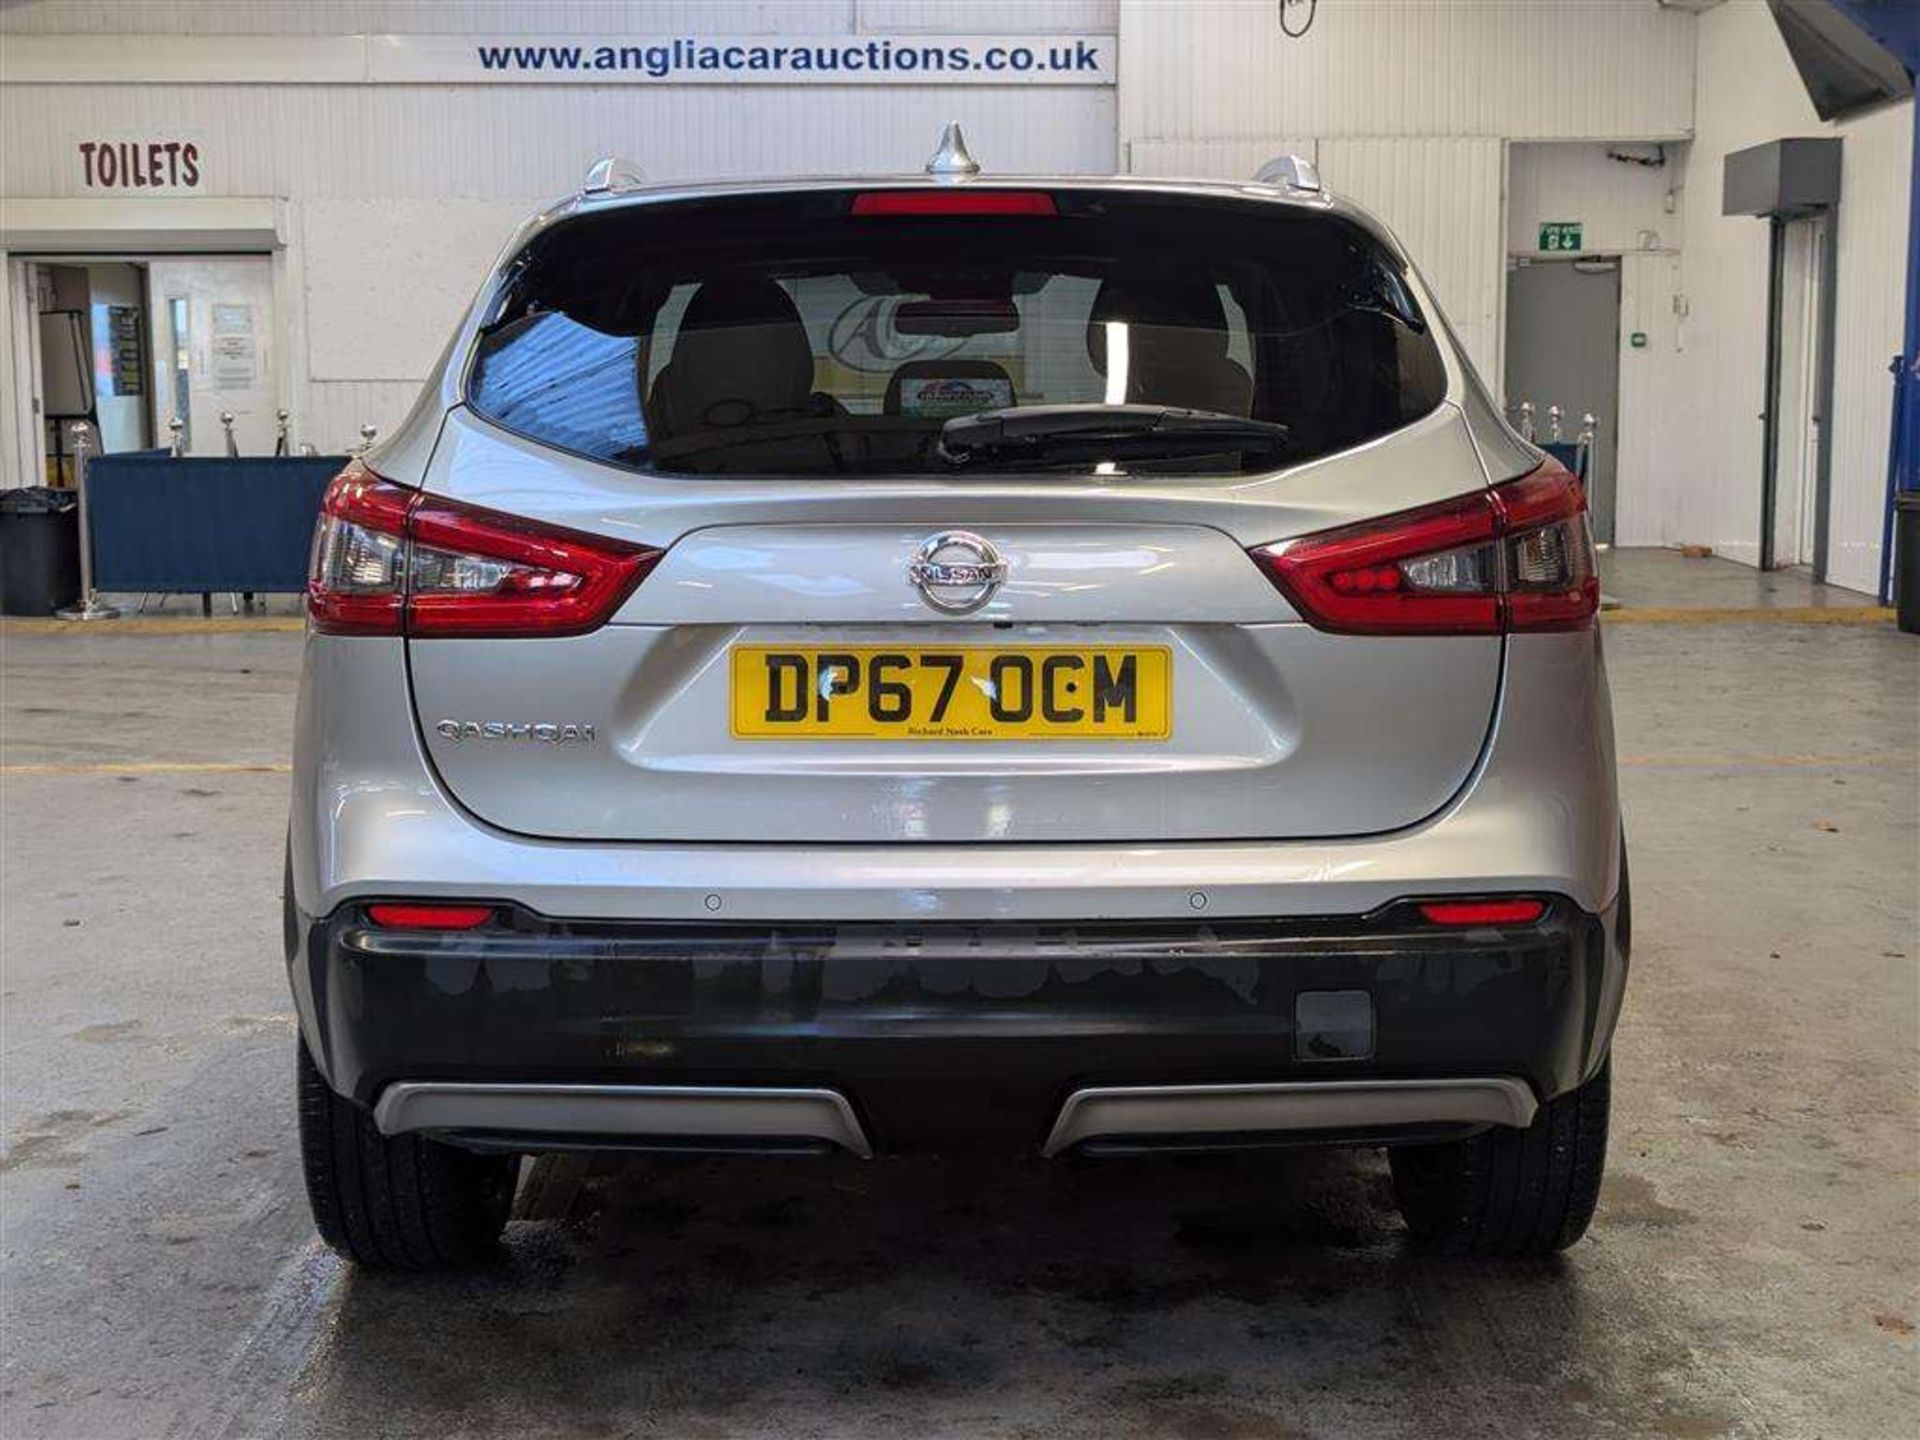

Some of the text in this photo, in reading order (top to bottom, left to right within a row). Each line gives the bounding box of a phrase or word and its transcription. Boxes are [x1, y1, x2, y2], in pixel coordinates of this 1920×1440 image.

[478, 40, 1099, 77] www.angliacarauctions.co.uk
[79, 142, 199, 187] TOILETS
[920, 565, 994, 582] NISSAN
[765, 654, 1137, 723] DP67 OCM
[436, 719, 597, 744] QASHQAI
